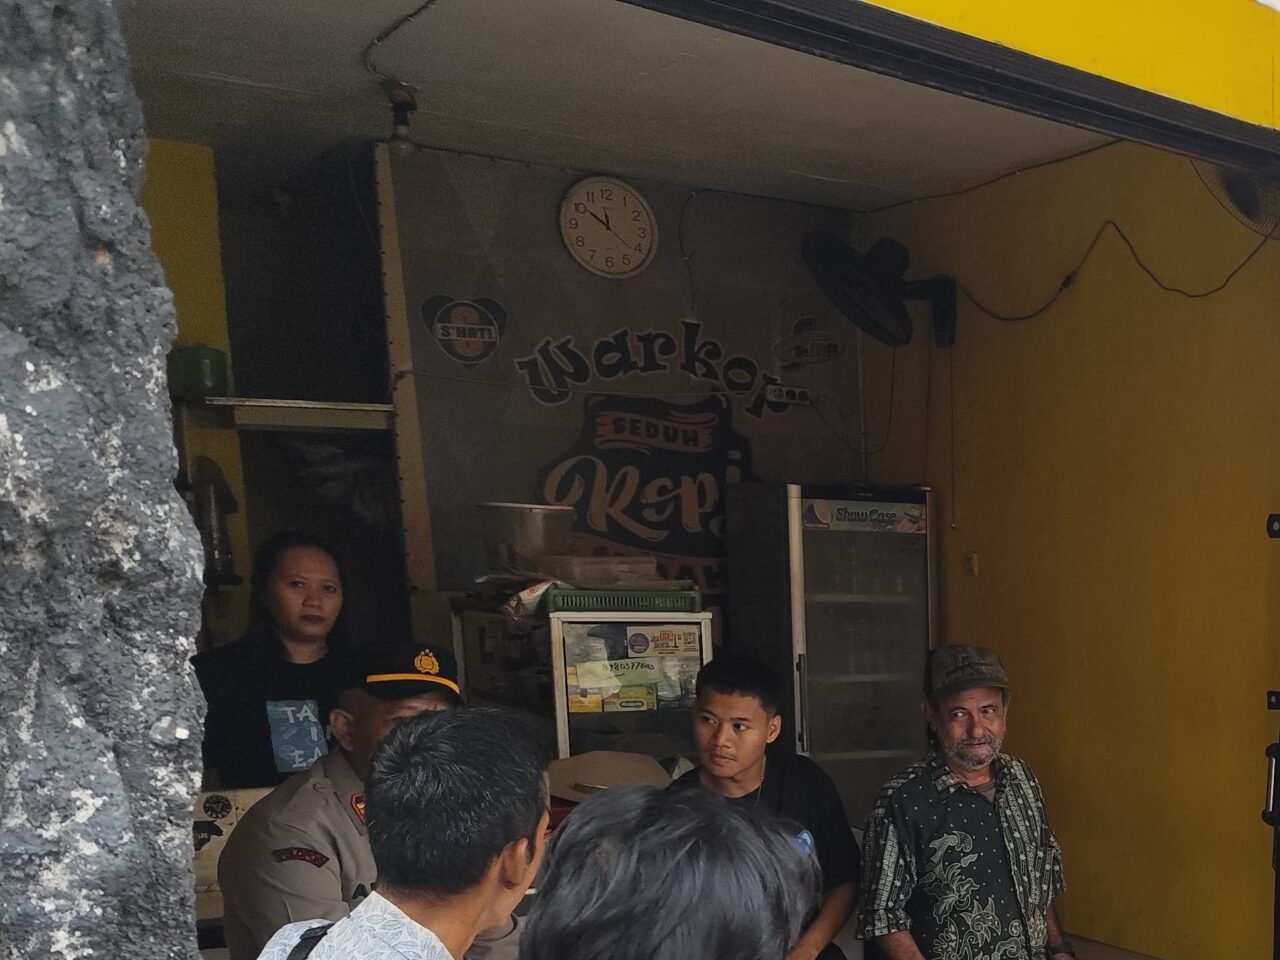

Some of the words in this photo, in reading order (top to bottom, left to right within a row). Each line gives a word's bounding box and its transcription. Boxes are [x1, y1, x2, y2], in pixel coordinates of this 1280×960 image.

[586, 191, 595, 202] 11
[600, 189, 613, 201] 12
[574, 202, 587, 214] 10
[632, 209, 641, 222] 2
[568, 217, 578, 230] 9
[637, 227, 647, 239] 3
[575, 235, 585, 248] 8
[634, 242, 642, 252] 4
[588, 249, 597, 261] 7
[622, 253, 632, 266] 5
[605, 256, 615, 268] 6
[611, 415, 700, 448] SEDUH
